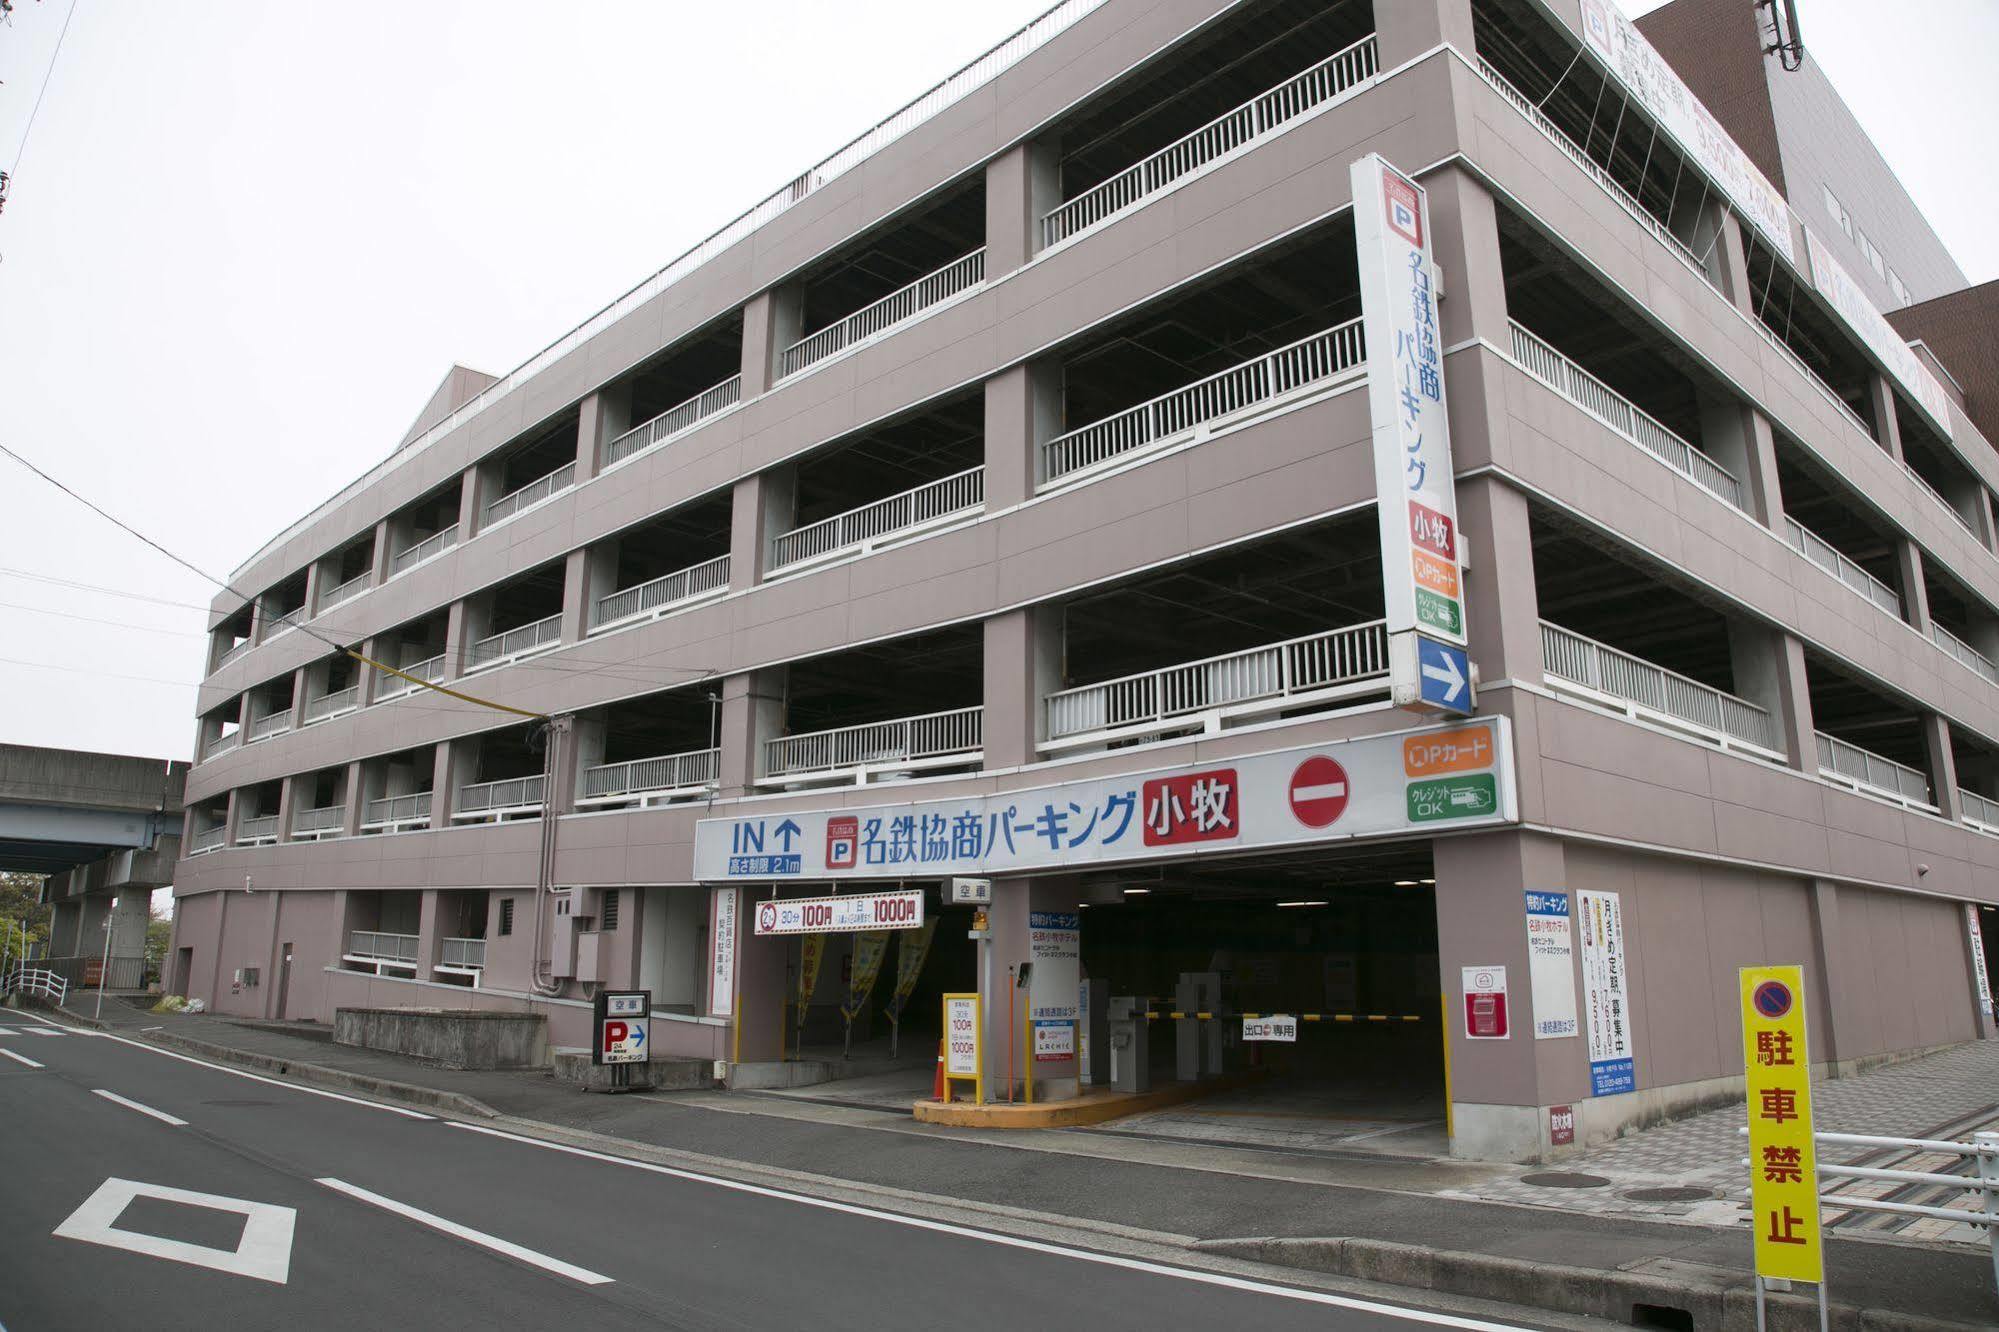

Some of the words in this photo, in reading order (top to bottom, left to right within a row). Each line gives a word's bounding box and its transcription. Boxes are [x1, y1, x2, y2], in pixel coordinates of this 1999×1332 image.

[1396, 203, 1412, 227] P
[1408, 250, 1440, 402] 名鉄協商
[1396, 329, 1426, 491] パーキング
[1414, 510, 1450, 551] 小牧
[1421, 608, 1436, 624] OK
[1412, 786, 1451, 803] クレジット
[1147, 778, 1236, 836] 小牧
[1417, 802, 1443, 816] OK
[733, 821, 765, 854] IN
[861, 790, 1137, 864] 名鉄協商パーキング
[834, 843, 848, 860] P
[730, 857, 769, 874] 高さ制限
[773, 858, 800, 873] 2.1m
[960, 885, 986, 898] 空車
[874, 898, 916, 923] 1000円
[1526, 894, 1567, 912] 特約パーキング
[781, 911, 800, 924] 30分
[802, 905, 833, 927] 100円
[953, 1019, 972, 1031] 100円
[1245, 1024, 1263, 1036] 出口
[1273, 1025, 1295, 1037] 専用
[605, 1022, 628, 1053] P
[952, 1042, 975, 1054] 1000円
[1756, 1030, 1807, 1247] 駐車禁止
